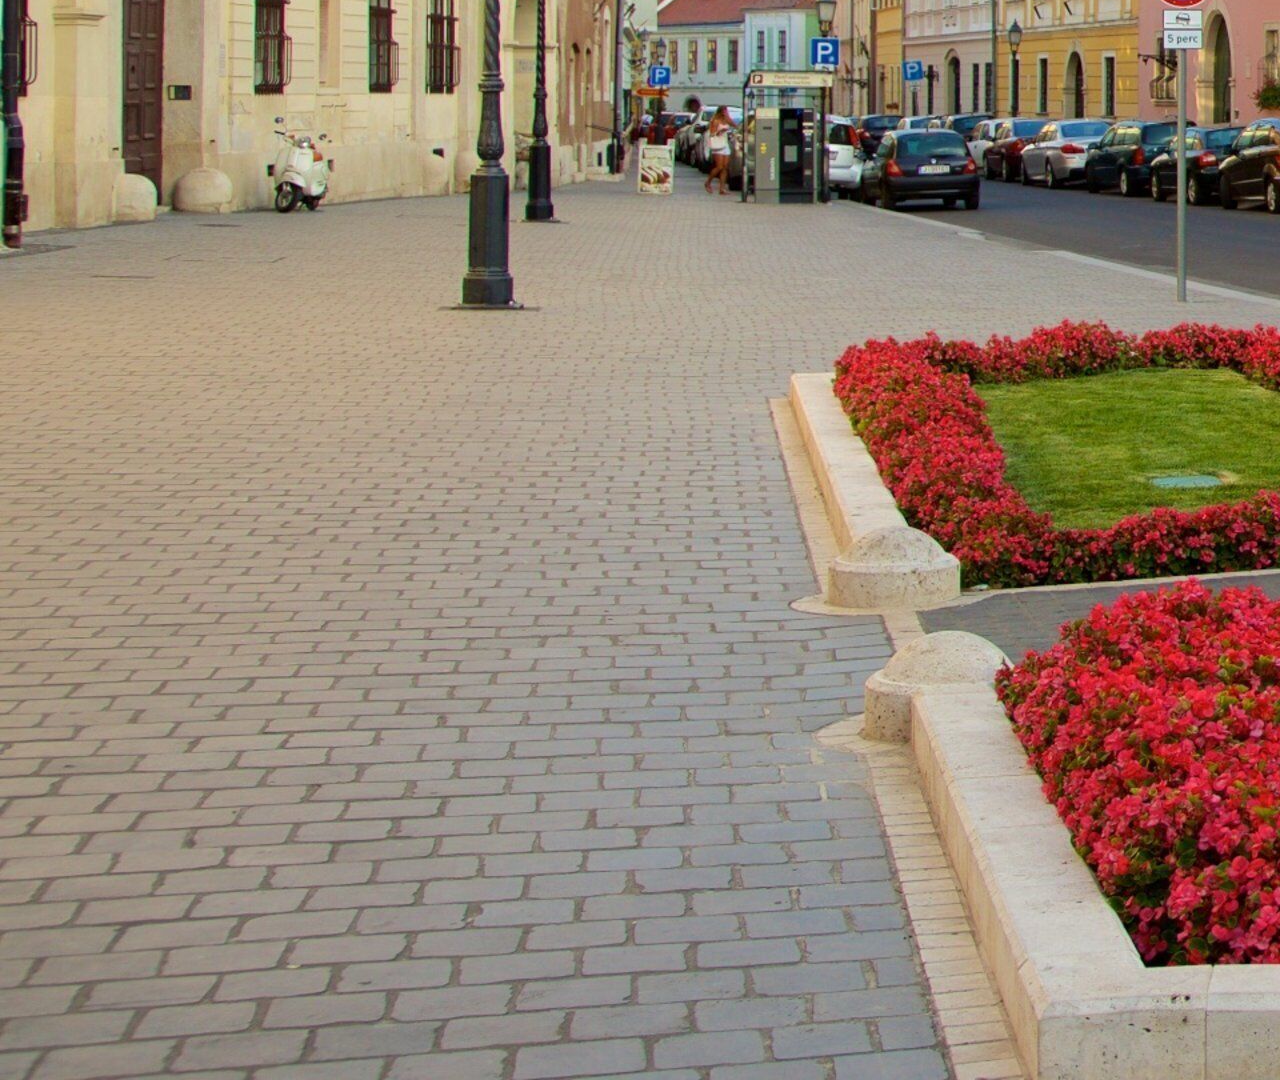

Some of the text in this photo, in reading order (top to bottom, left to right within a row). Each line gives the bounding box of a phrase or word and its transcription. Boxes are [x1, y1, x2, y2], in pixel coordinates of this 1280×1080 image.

[1168, 34, 1198, 44] 5 perc
[817, 42, 833, 62] P
[655, 69, 666, 82] P
[906, 63, 919, 78] P
